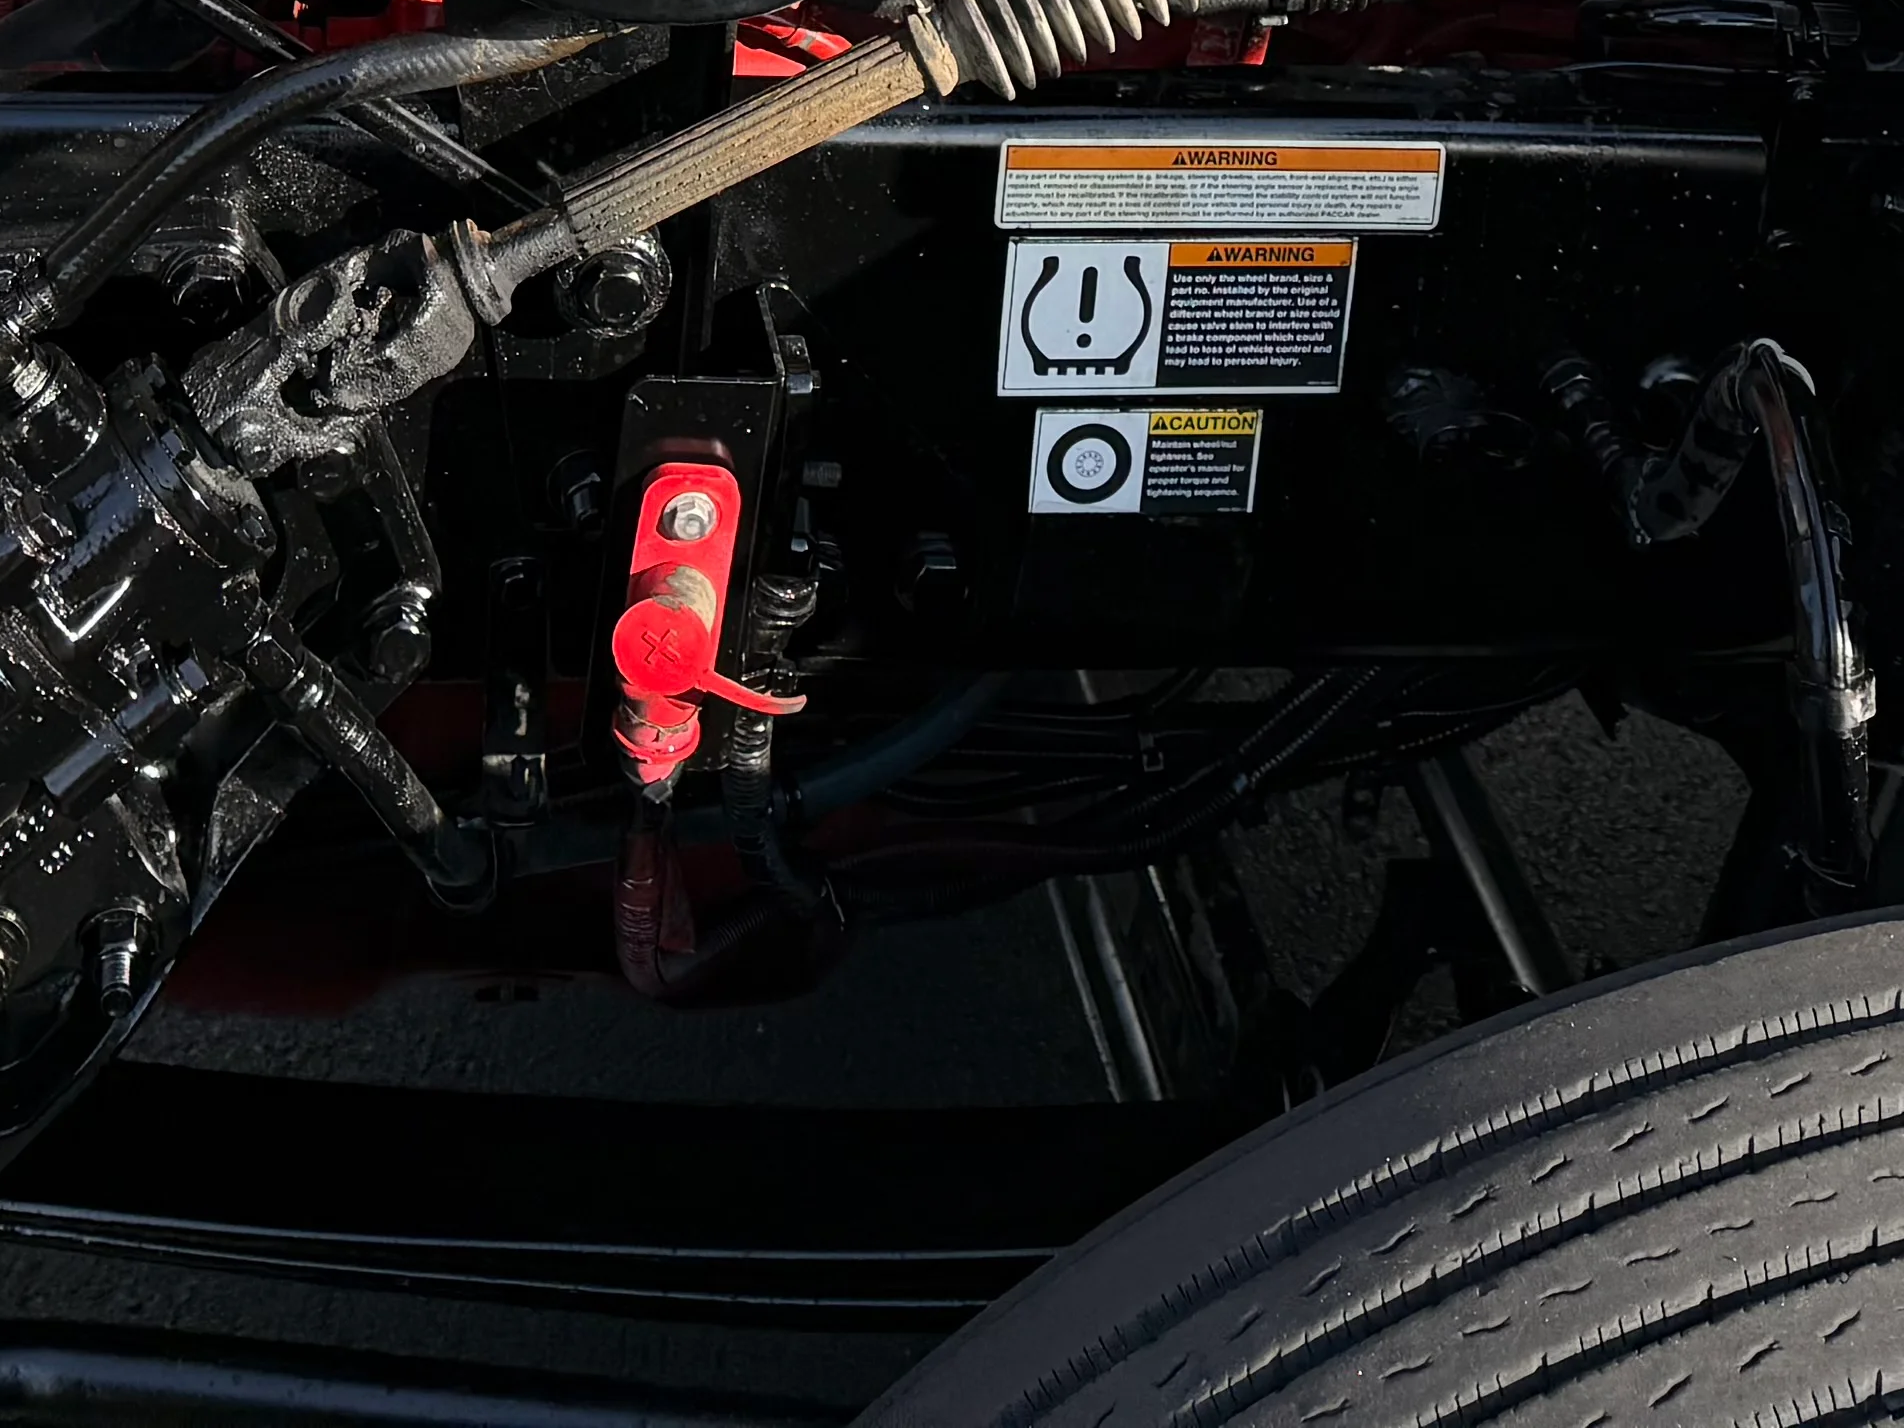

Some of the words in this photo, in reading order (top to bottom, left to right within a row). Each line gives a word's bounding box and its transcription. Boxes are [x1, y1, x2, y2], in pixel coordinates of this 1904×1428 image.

[1188, 151, 1278, 166] WARNING
[1224, 247, 1315, 262] WARNING
[1172, 273, 1192, 282] Use
[1194, 273, 1216, 284] only
[1218, 273, 1235, 282] the
[1237, 273, 1267, 282] wheel
[1268, 273, 1301, 284] brand,
[1303, 273, 1323, 282] size
[1171, 285, 1192, 296] part
[1272, 285, 1288, 294] the
[1290, 285, 1328, 296] original
[1170, 298, 1223, 309] equipment
[1225, 298, 1294, 307] manufacturer.
[1296, 298, 1316, 307] Use
[1169, 309, 1211, 318] different
[1213, 309, 1243, 318] wheel
[1244, 309, 1274, 318] brand
[1289, 309, 1309, 318] size
[1311, 309, 1340, 318] could
[1200, 321, 1226, 330] valve
[1228, 321, 1253, 330] stem
[1268, 321, 1310, 330] interfere
[1312, 321, 1333, 330] with
[1175, 333, 1203, 342] brake
[1205, 333, 1262, 344] component
[1264, 333, 1294, 342] which
[1295, 333, 1324, 342] could
[1165, 344, 1187, 353] lead
[1201, 344, 1222, 353] loss
[1237, 344, 1273, 353] vehicle
[1275, 344, 1311, 353] control
[1312, 344, 1331, 353] and
[1164, 358, 1185, 367] may
[1187, 356, 1209, 365] lead
[1223, 356, 1268, 367] personal
[1269, 356, 1302, 367] injury.
[1169, 416, 1256, 430] CAUTION
